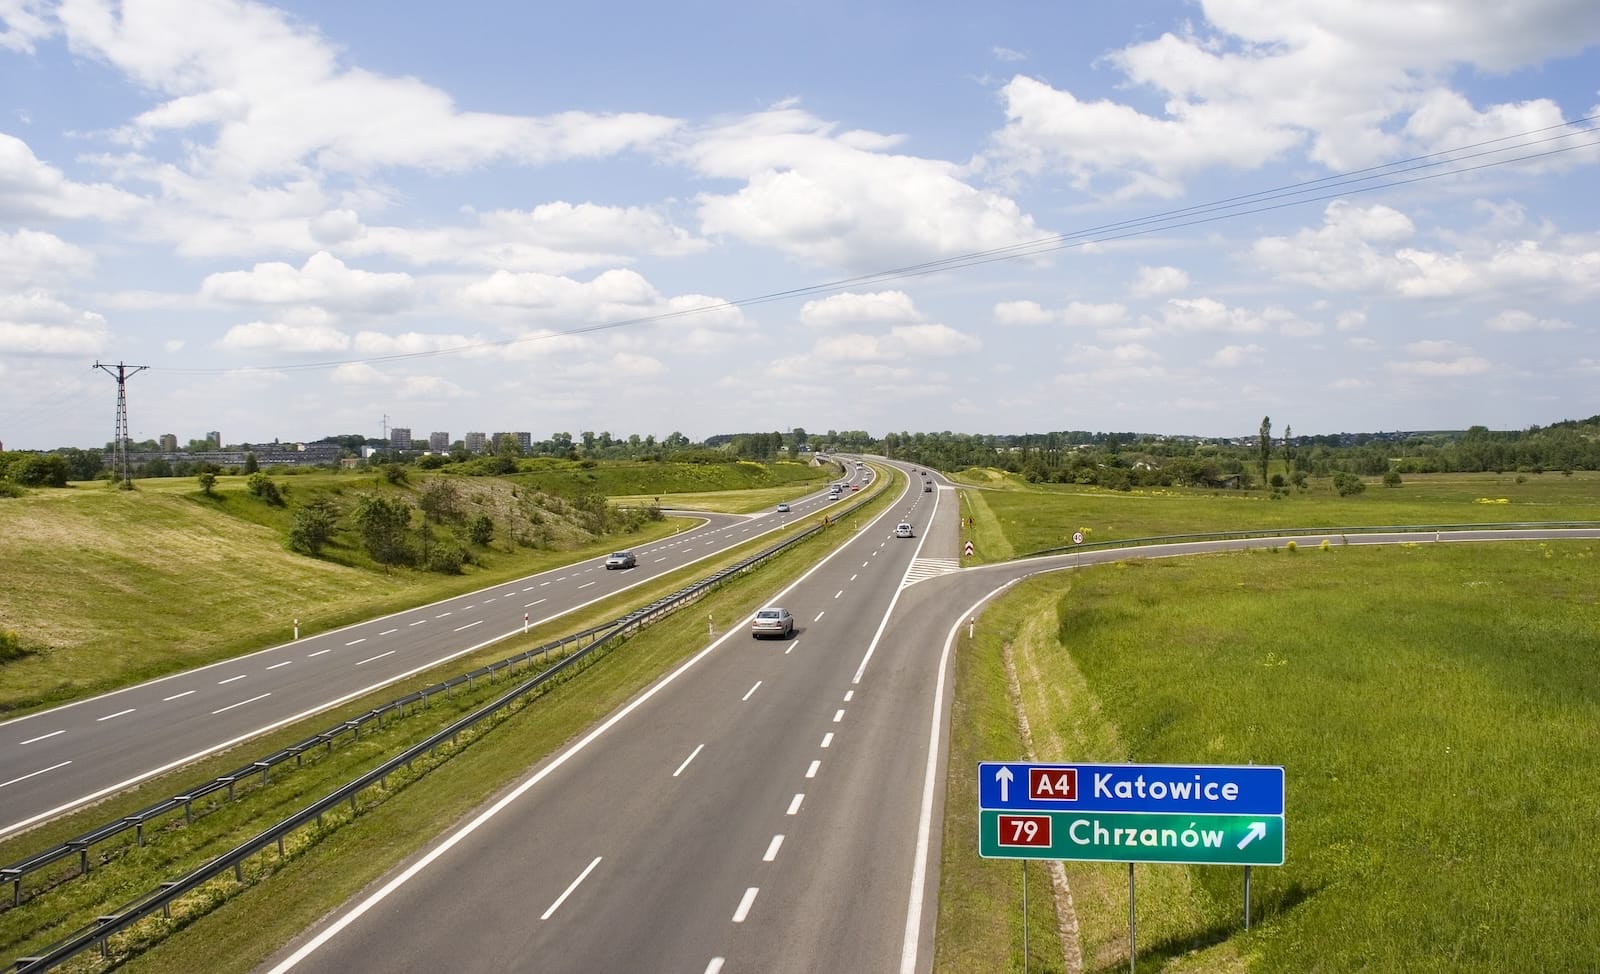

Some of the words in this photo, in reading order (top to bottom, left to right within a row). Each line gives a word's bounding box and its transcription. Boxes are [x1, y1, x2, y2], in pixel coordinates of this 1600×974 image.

[1036, 773, 1070, 795] A4
[1094, 773, 1239, 800] Katowice
[1010, 820, 1039, 842] 79
[1069, 819, 1224, 848] Chrzanów
